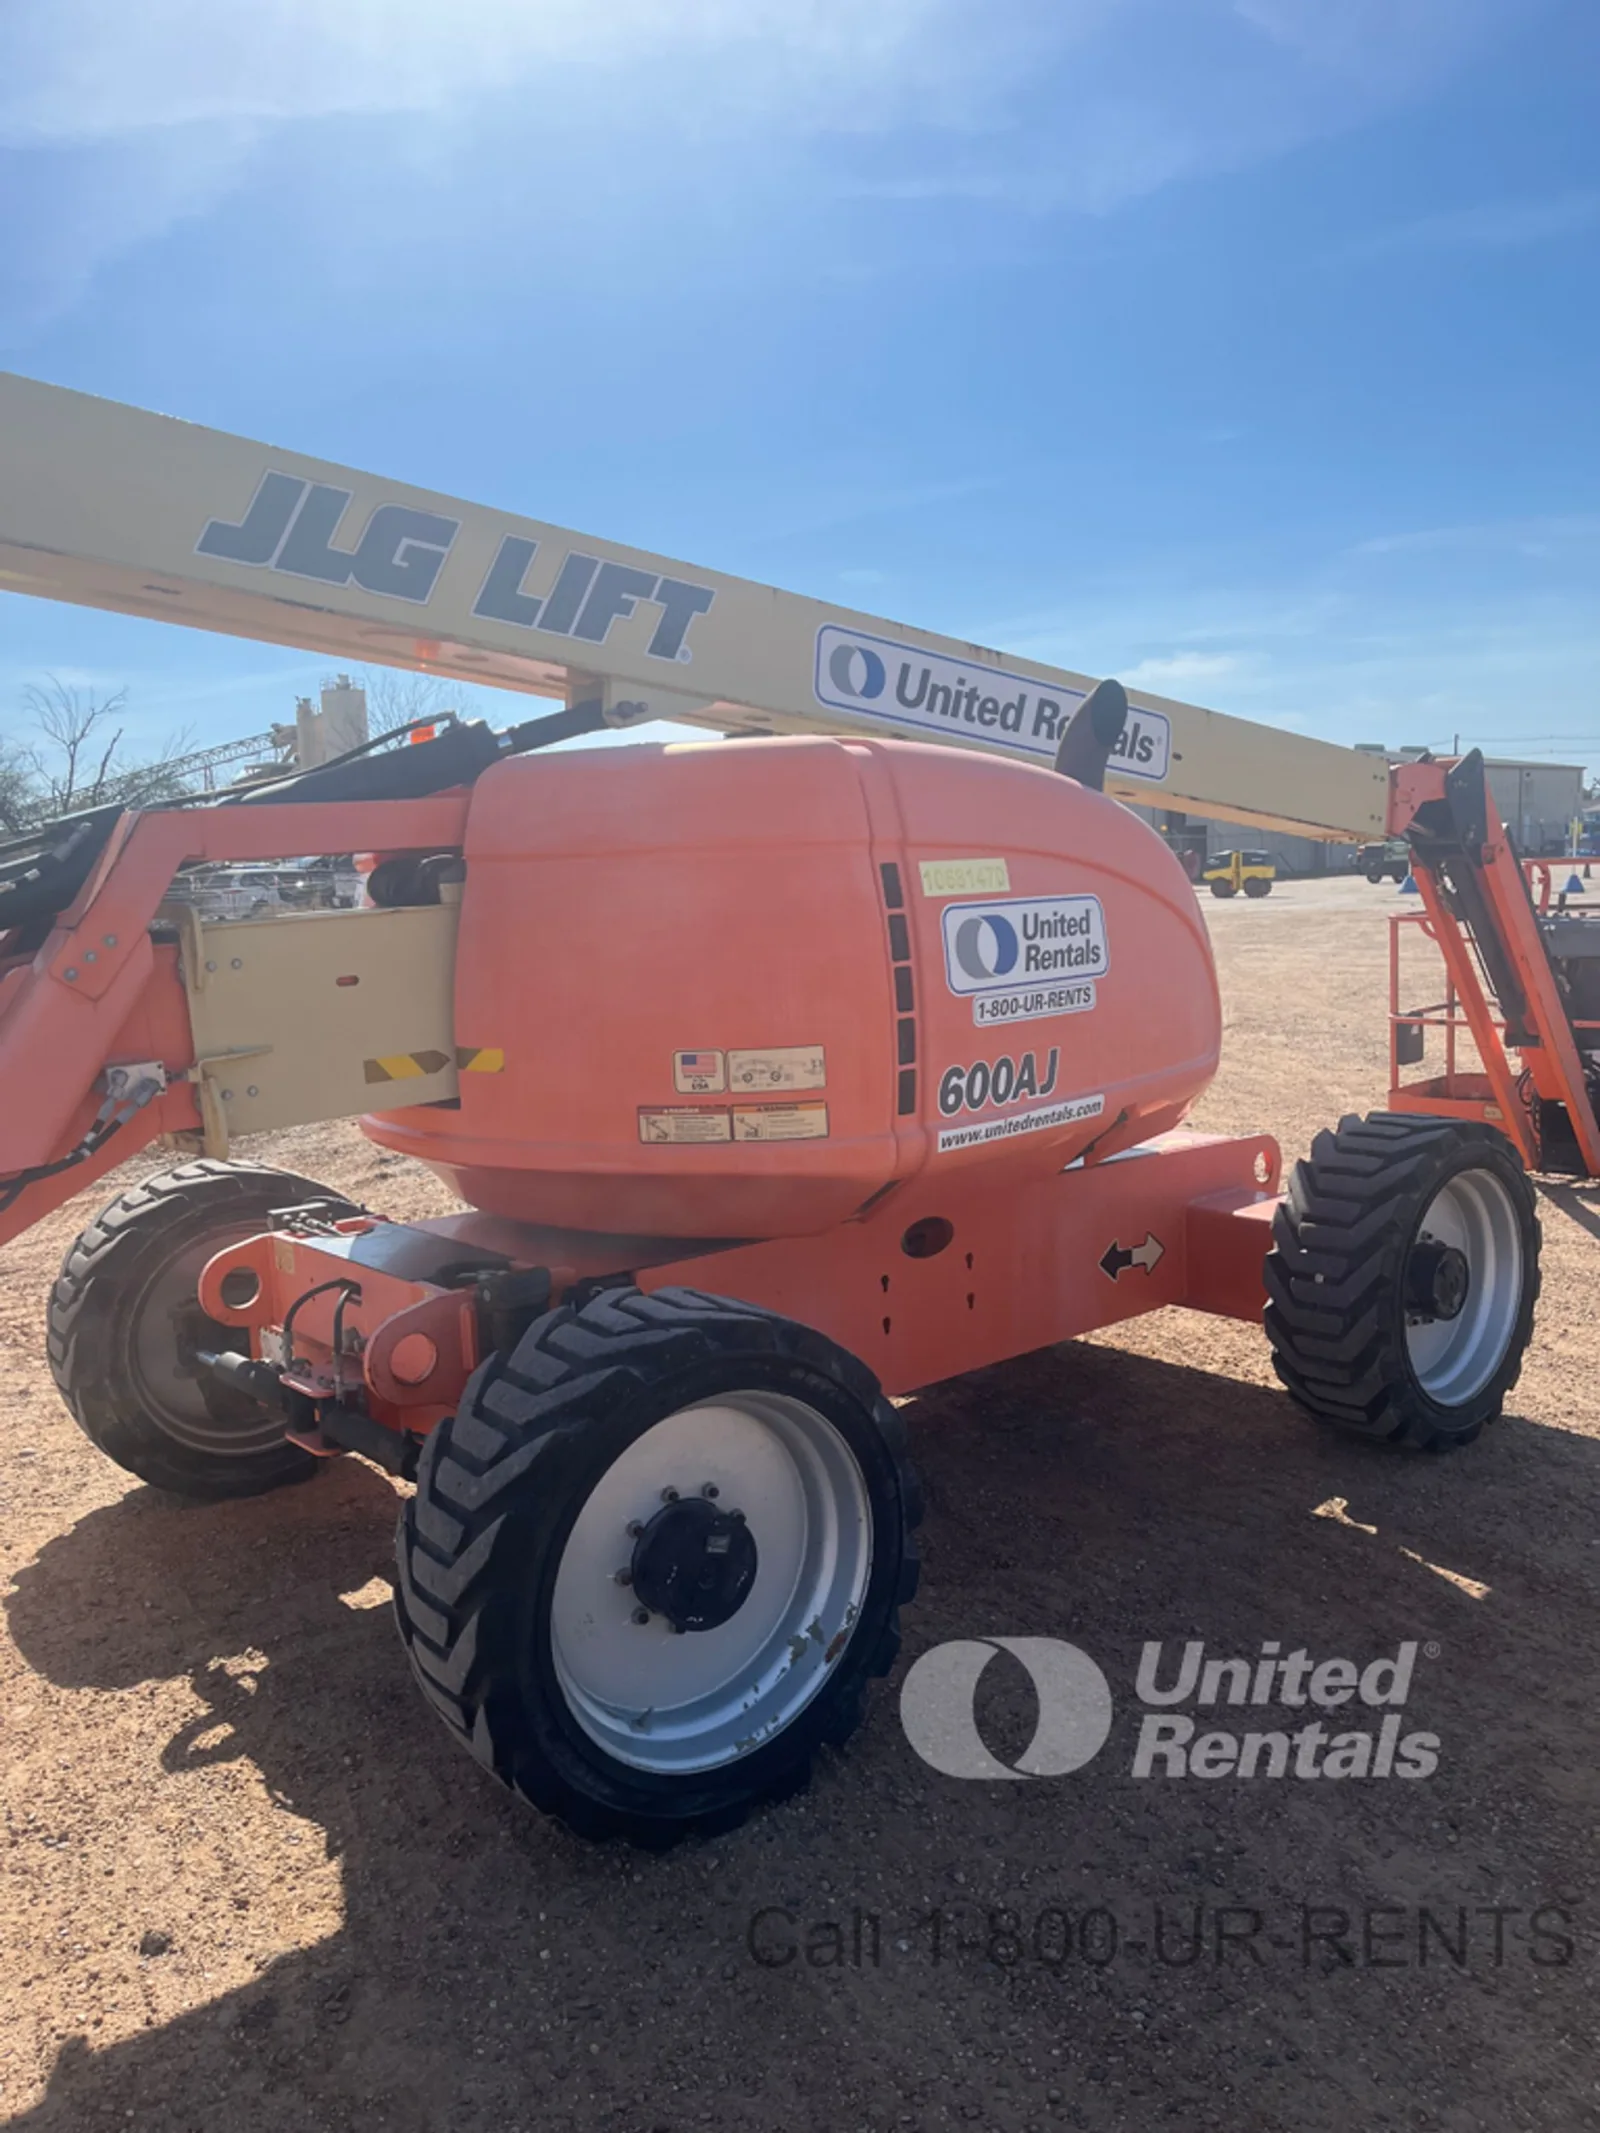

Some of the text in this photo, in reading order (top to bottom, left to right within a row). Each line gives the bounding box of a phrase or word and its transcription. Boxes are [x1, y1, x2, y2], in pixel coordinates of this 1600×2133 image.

[195, 468, 717, 660] JLG LIFT
[896, 662, 1027, 733] United
[1022, 908, 1091, 941] United
[1024, 938, 1102, 973] Rentals
[977, 985, 1092, 1019] 1-800-UR-RENTS
[939, 1047, 1059, 1117] 600AJ
[940, 1101, 1102, 1150] www.unitedrentals.com
